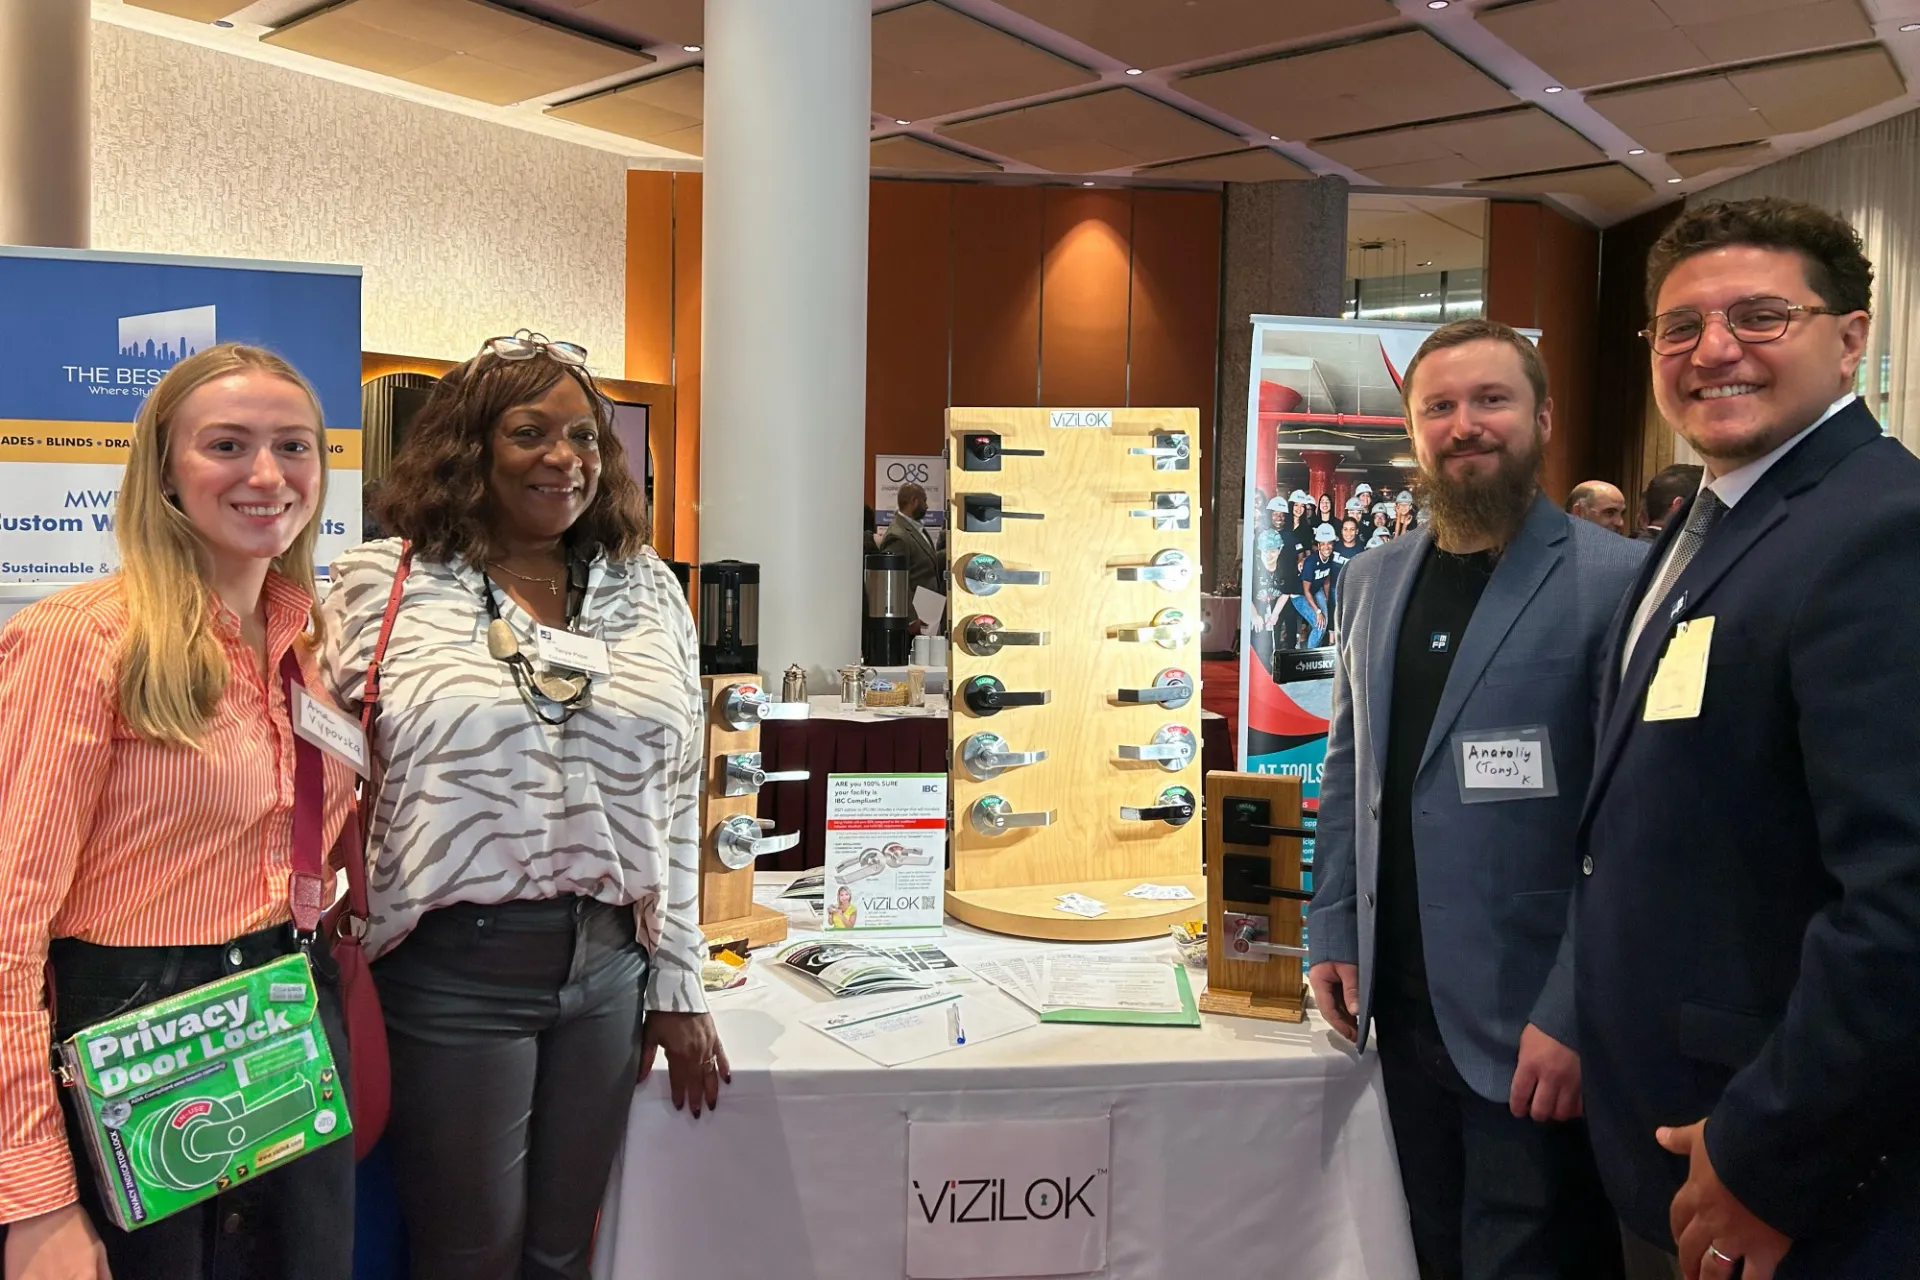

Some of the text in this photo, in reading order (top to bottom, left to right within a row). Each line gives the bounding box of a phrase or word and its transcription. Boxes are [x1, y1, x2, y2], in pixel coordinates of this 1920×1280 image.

[62, 365, 110, 384] THE
[88, 385, 129, 396] Where
[46, 437, 94, 448] BLINDS
[887, 462, 928, 483] O&S
[2, 562, 110, 574] Sustainable &
[1305, 660, 1334, 670] HUSKY
[1468, 745, 1531, 763] Anatoliy
[1476, 761, 1519, 777] (Tony)
[847, 797, 882, 805] Compliant?
[87, 994, 248, 1069] Privacy
[98, 1043, 194, 1095] Door
[200, 1008, 293, 1059] Lock
[109, 1130, 143, 1220] PRIVACY INDICATOR LOCK
